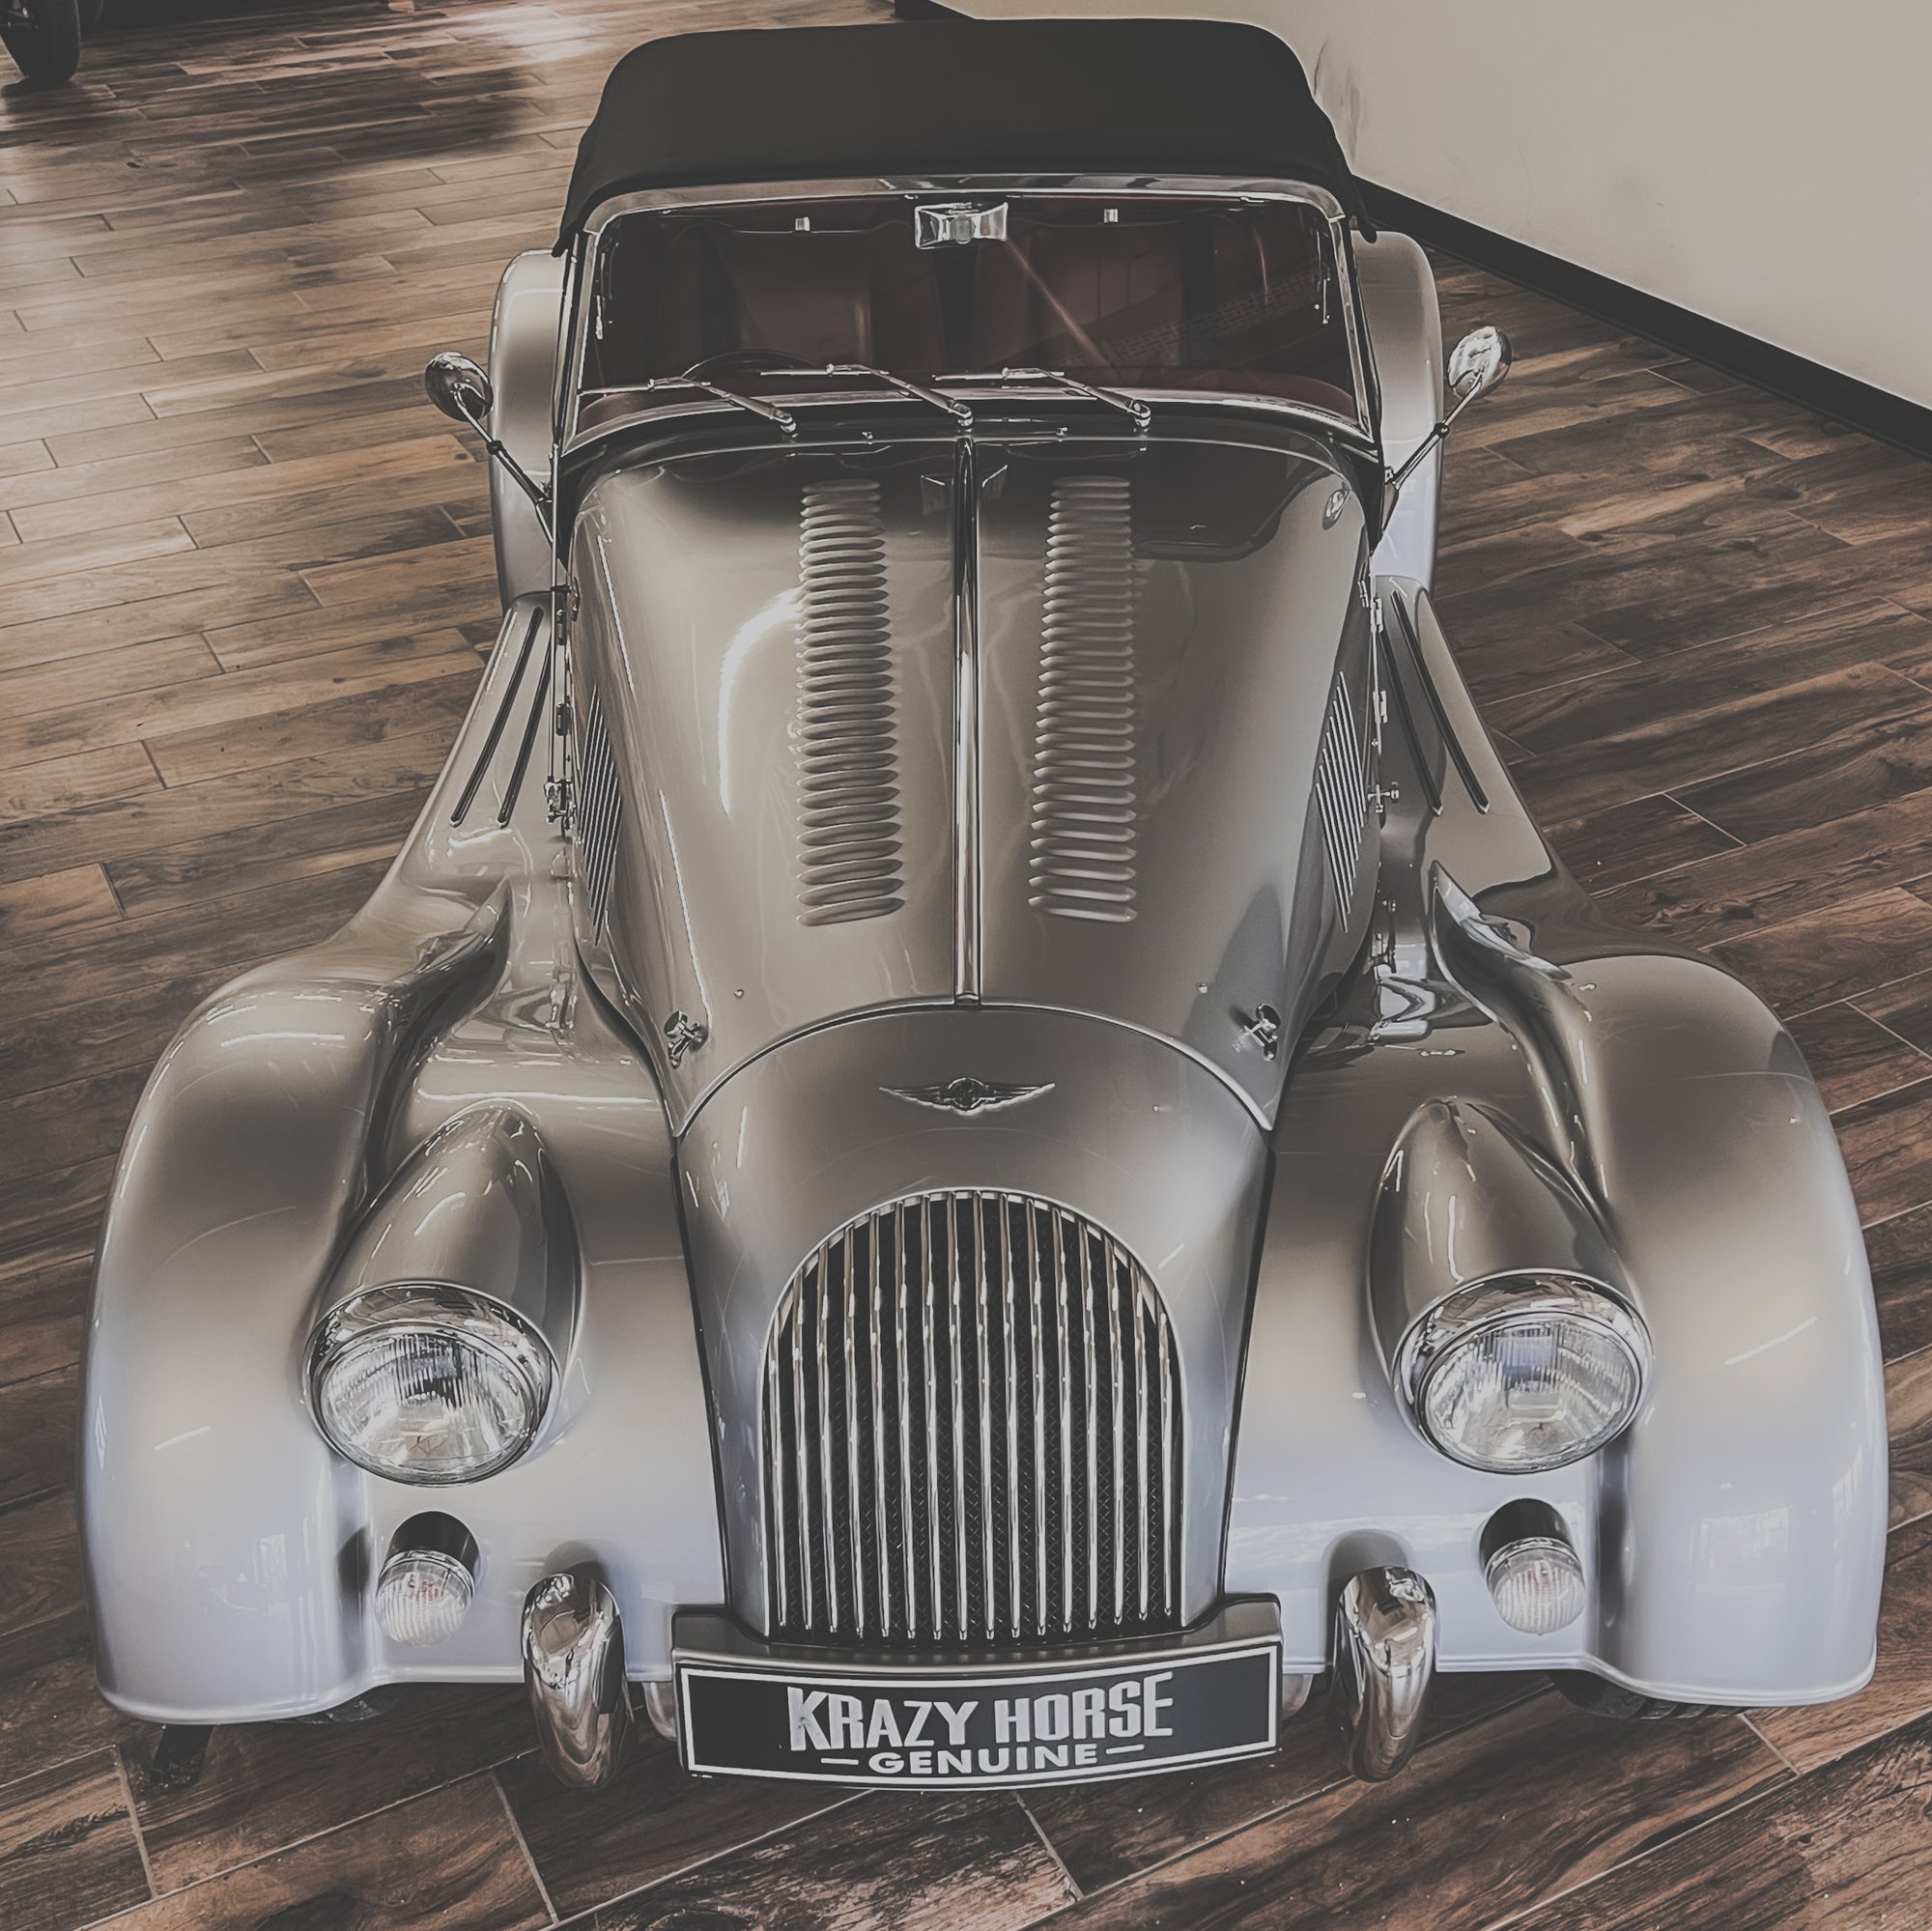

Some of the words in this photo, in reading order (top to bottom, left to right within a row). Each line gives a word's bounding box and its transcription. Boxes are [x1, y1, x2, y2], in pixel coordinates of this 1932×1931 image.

[786, 1686, 979, 1751] KRAZY
[994, 1671, 1174, 1744] HORSE
[868, 1744, 1098, 1775] GENUINE
